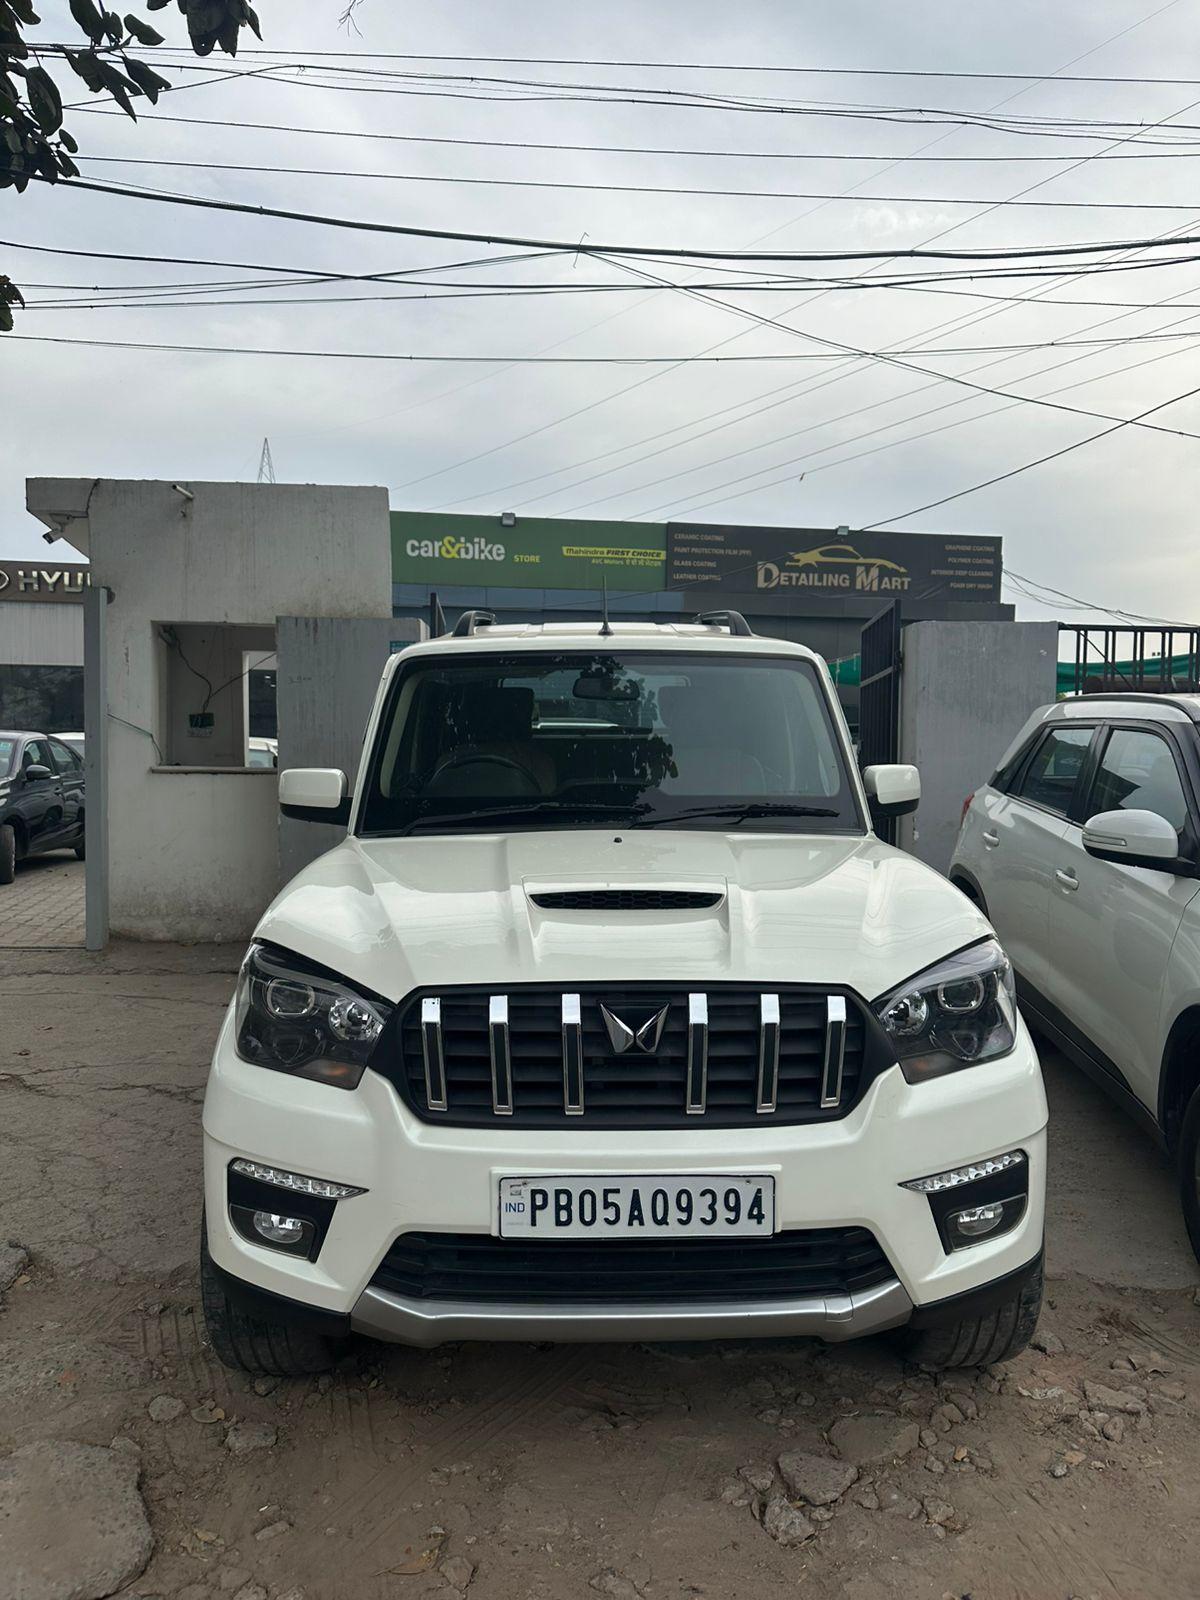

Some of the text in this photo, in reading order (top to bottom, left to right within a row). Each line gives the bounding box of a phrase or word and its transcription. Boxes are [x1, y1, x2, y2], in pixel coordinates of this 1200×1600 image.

[674, 533, 725, 542] CERAMIC COATING
[406, 536, 542, 563] car&bike STORE
[566, 548, 663, 558] Mahindra FIRST CHOICE
[690, 547, 725, 555] PROTECTION
[673, 559, 717, 568] GLASS COATING
[971, 557, 994, 565] COATING
[673, 572, 723, 582] LEATHER COATING
[756, 561, 851, 589] DETAILING
[18, 570, 91, 593] HYU
[504, 1202, 526, 1213] IND
[530, 1187, 766, 1227] PB05AQ9394
